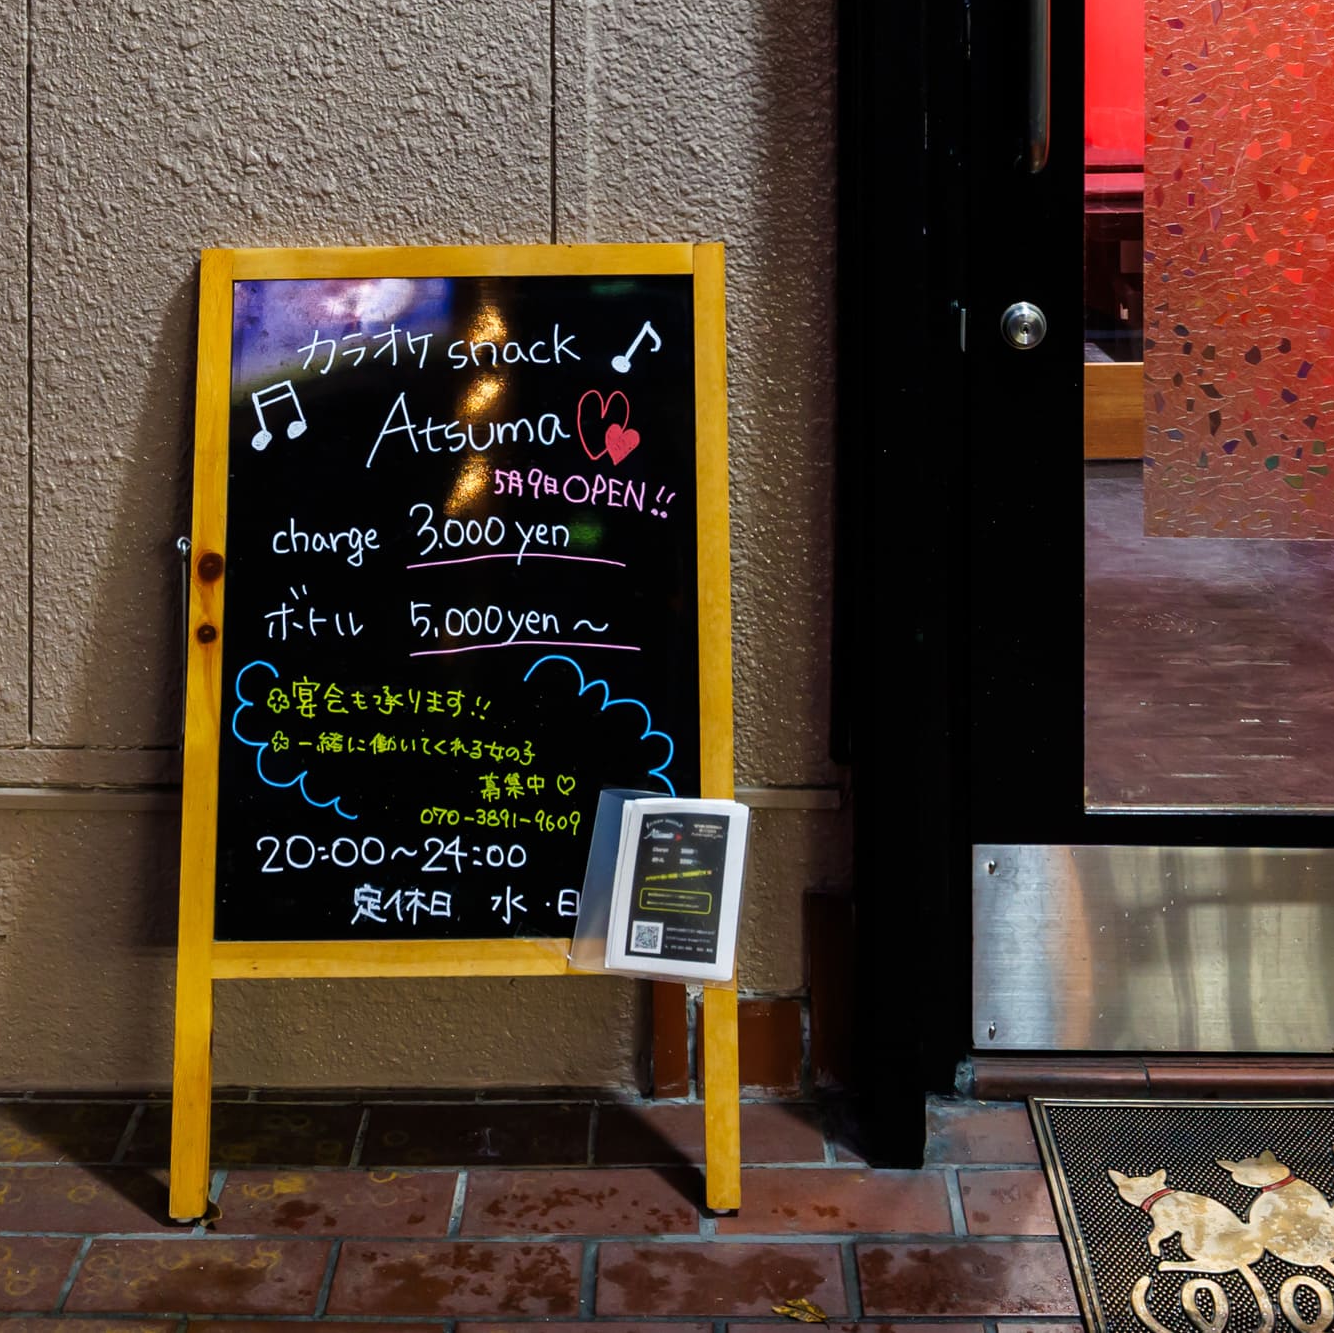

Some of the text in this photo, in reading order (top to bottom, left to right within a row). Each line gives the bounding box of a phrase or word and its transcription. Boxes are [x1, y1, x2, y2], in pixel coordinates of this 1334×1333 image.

[297, 323, 581, 374] カラオケ snack
[366, 392, 571, 468] Atsuma
[272, 517, 380, 567] charge
[516, 520, 570, 565] yen
[264, 584, 364, 641] ボトル
[298, 731, 536, 766] 一緒に働いてくれる女の子
[420, 806, 581, 836] 070-3891-9609
[350, 882, 452, 925] 定休日
